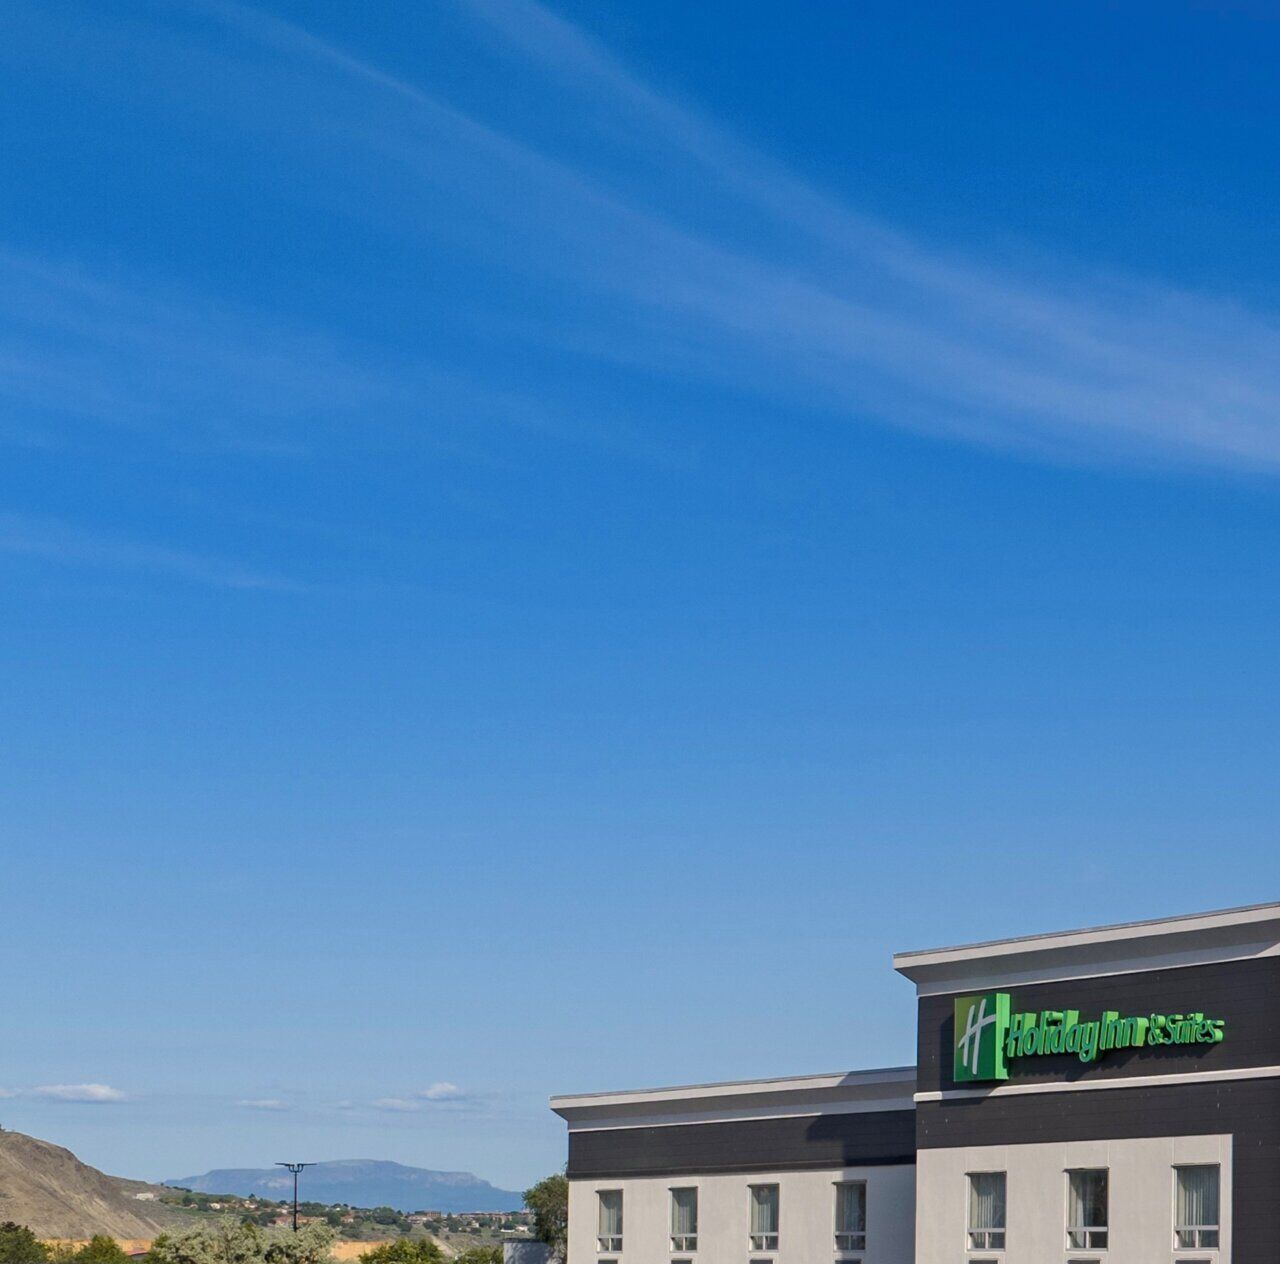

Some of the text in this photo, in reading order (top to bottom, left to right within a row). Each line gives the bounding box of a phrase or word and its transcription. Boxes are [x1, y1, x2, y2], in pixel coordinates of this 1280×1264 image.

[1006, 1010, 1099, 1063] Holiday
[1100, 1011, 1150, 1050] Inn
[1164, 1012, 1226, 1045] Suites
